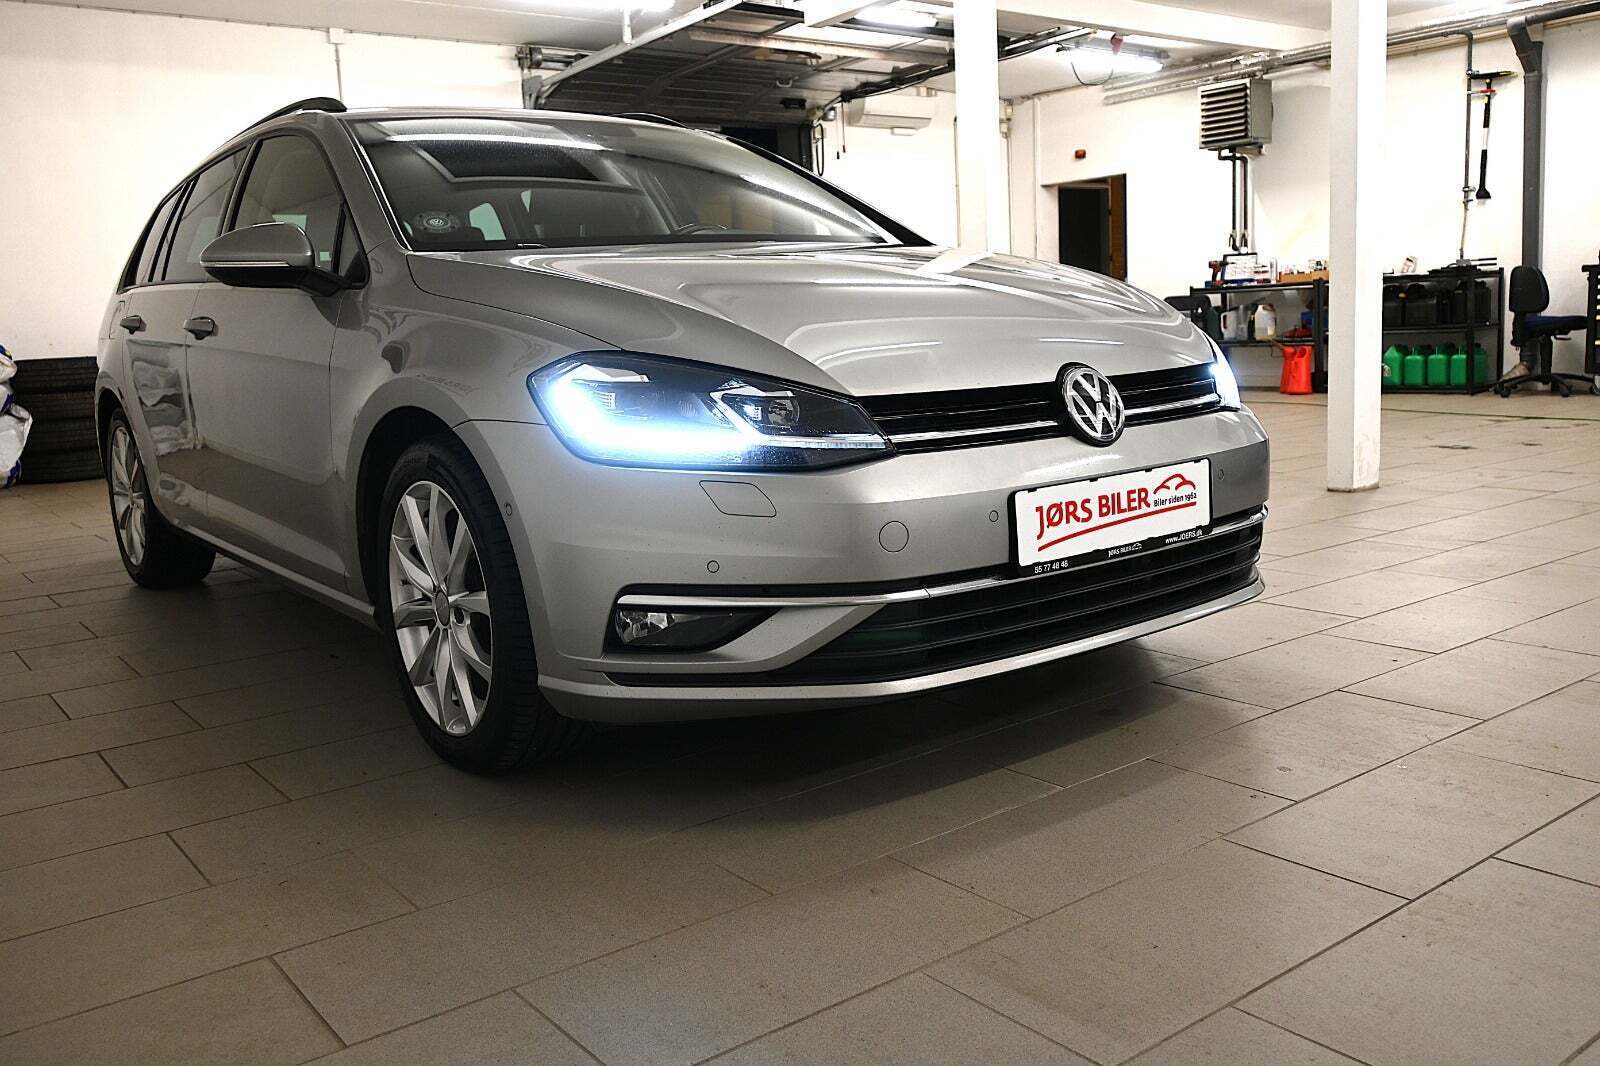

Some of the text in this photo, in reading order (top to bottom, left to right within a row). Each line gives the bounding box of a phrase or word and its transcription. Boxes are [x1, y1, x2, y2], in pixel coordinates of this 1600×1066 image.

[1154, 492, 1197, 507] Biler siden 1962
[1035, 487, 1151, 540] JØRS BILER
[1034, 565, 1043, 574] 55
[1043, 563, 1051, 571] 77
[1052, 561, 1060, 570] 48
